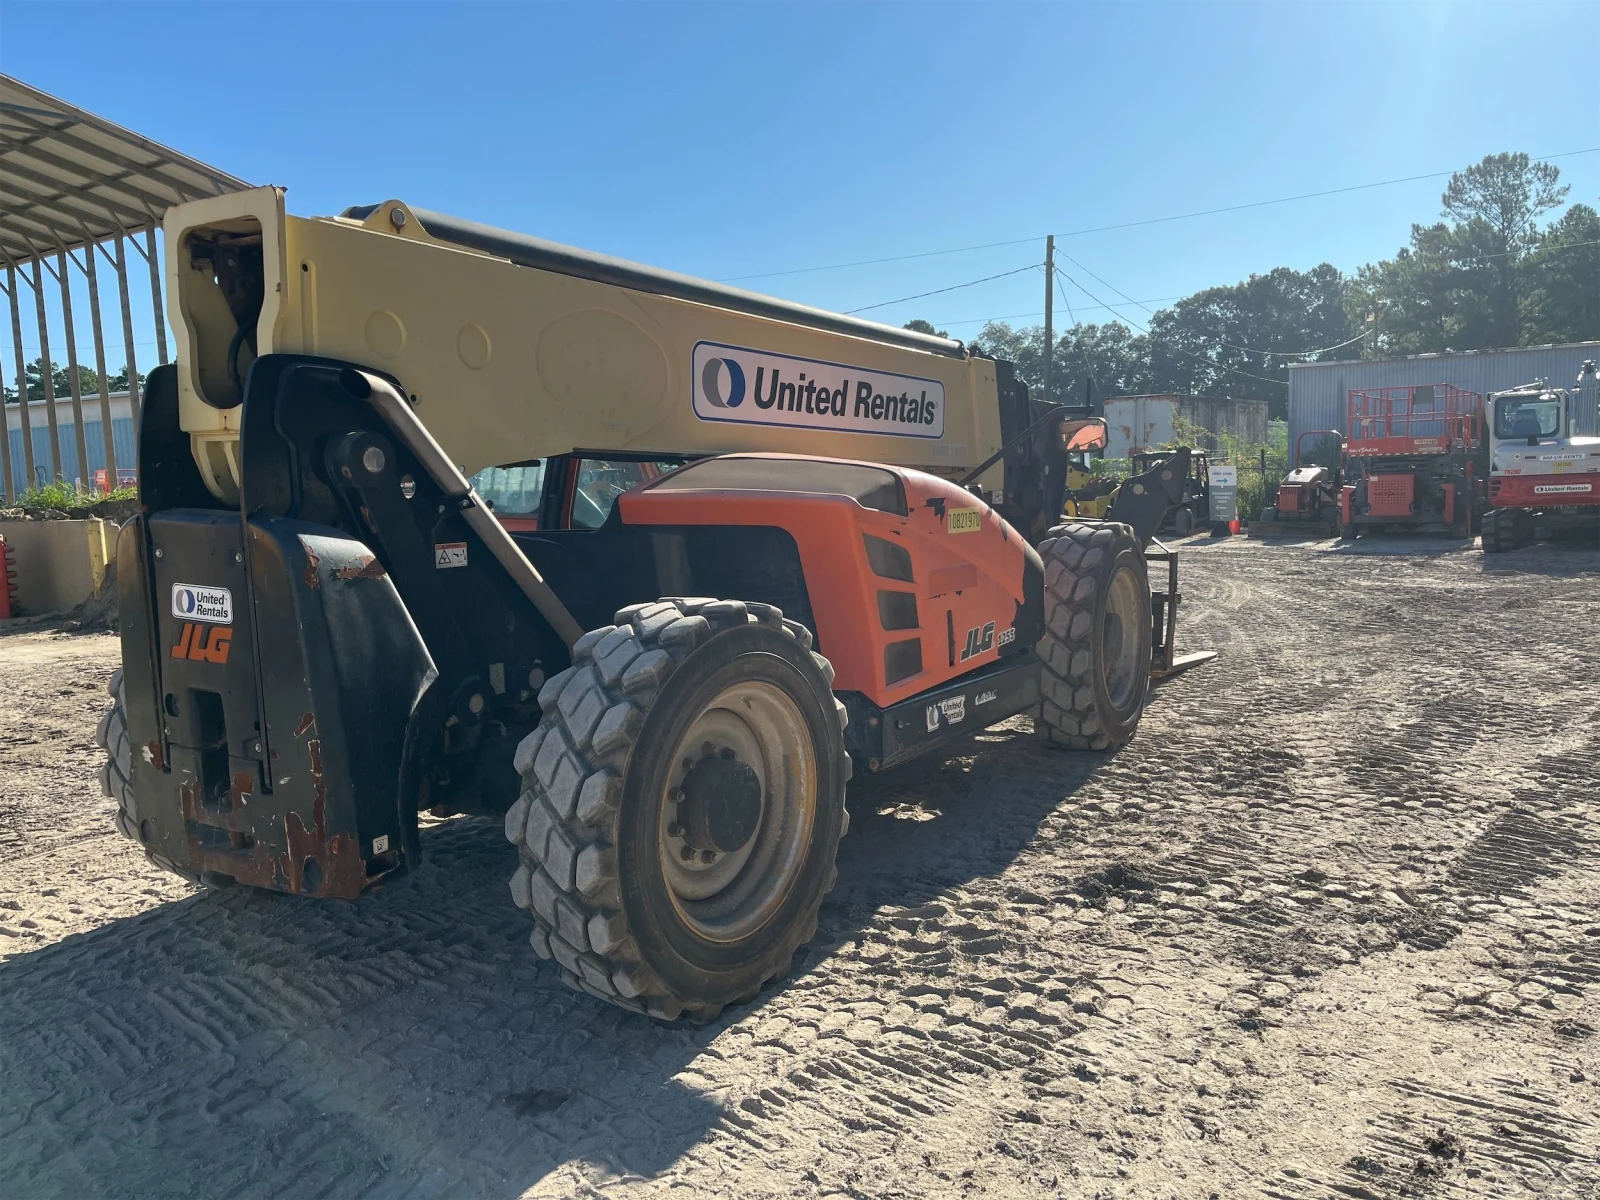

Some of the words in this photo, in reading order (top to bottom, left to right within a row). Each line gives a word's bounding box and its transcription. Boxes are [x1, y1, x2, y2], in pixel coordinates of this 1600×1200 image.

[754, 366, 849, 416] United
[854, 381, 936, 425] Rentals
[948, 511, 980, 529] 10821970
[196, 592, 225, 605] United
[196, 604, 229, 618] Rentals
[171, 623, 233, 664] JLG
[960, 620, 995, 663] JLG
[944, 699, 962, 712] United
